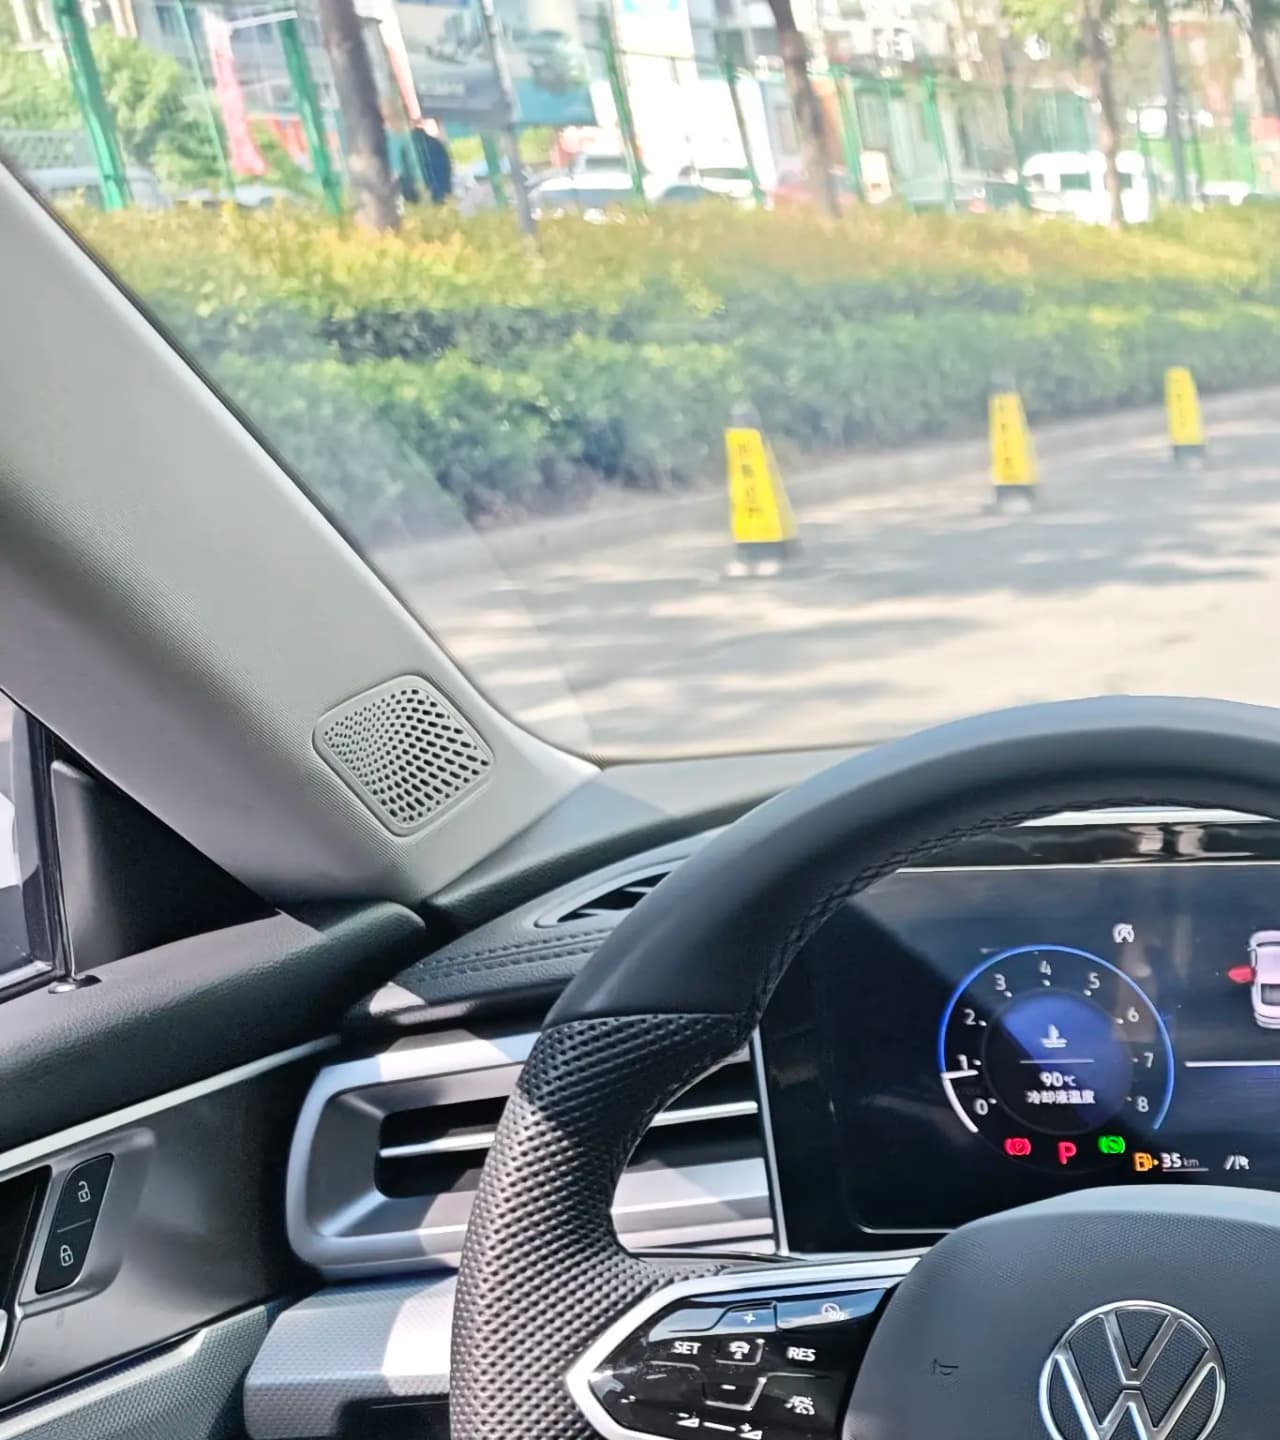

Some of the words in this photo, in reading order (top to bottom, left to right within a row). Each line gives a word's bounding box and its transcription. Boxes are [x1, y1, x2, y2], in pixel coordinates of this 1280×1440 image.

[1039, 961, 1052, 976] 4
[994, 974, 1006, 991] 3
[1088, 972, 1100, 989] 5
[964, 1009, 977, 1026] 2
[1127, 1007, 1140, 1022] 6
[957, 1054, 969, 1070] 1
[1143, 1052, 1154, 1068] 7
[1025, 1089, 1096, 1105] 冷却液温度
[1136, 1096, 1150, 1112] 8
[975, 1099, 989, 1116] 0
[1058, 1142, 1077, 1165] P
[1161, 1152, 1182, 1168] 35
[672, 1340, 702, 1355] SET
[786, 1346, 817, 1362] RES
